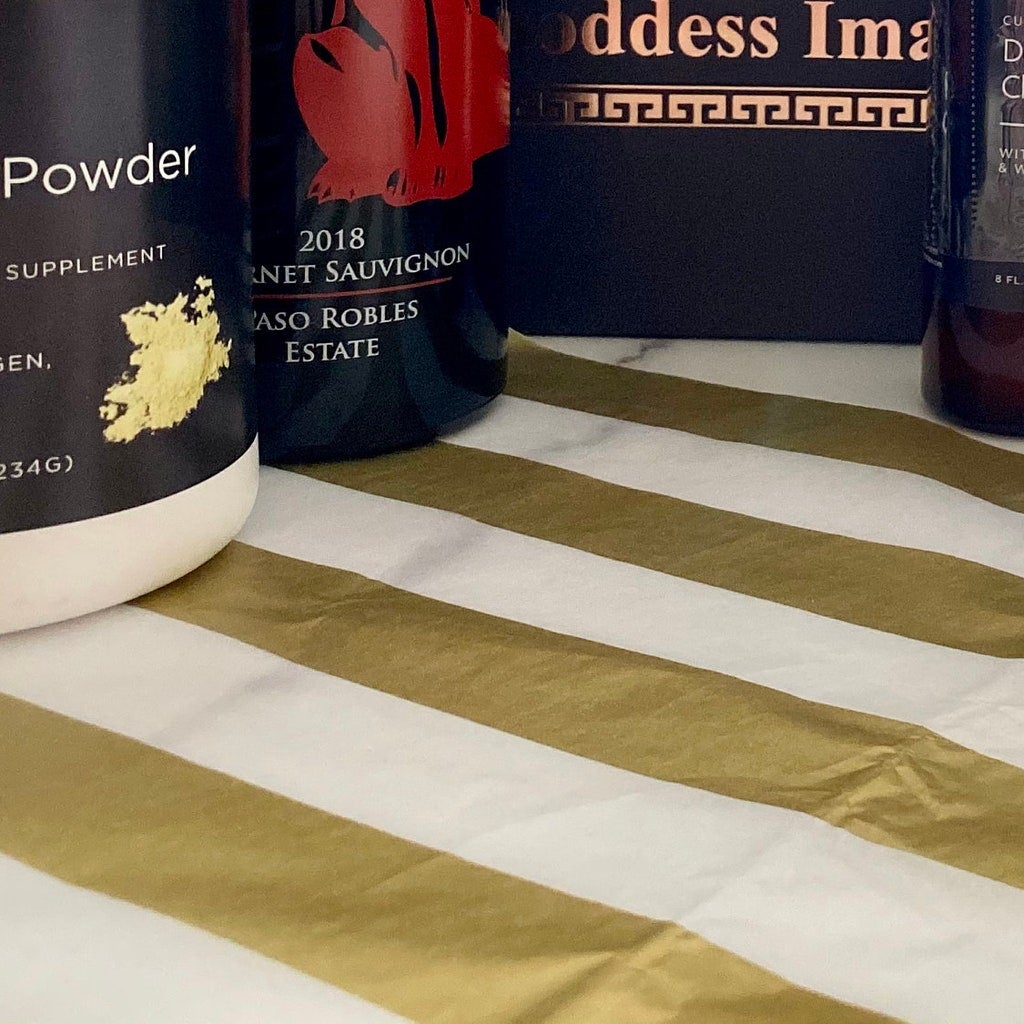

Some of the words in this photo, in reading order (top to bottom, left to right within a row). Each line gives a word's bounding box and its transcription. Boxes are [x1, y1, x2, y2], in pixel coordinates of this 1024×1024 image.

[2, 142, 197, 201] Powder
[998, 162, 1007, 174] &
[299, 227, 365, 252] 2018
[6, 244, 167, 280] SUPPLEMENT
[325, 242, 471, 283] SAUVIGNON
[994, 275, 1002, 283] 8
[253, 309, 310, 331] ASO
[321, 300, 419, 330] ROBLES
[285, 338, 380, 363] ESTATE
